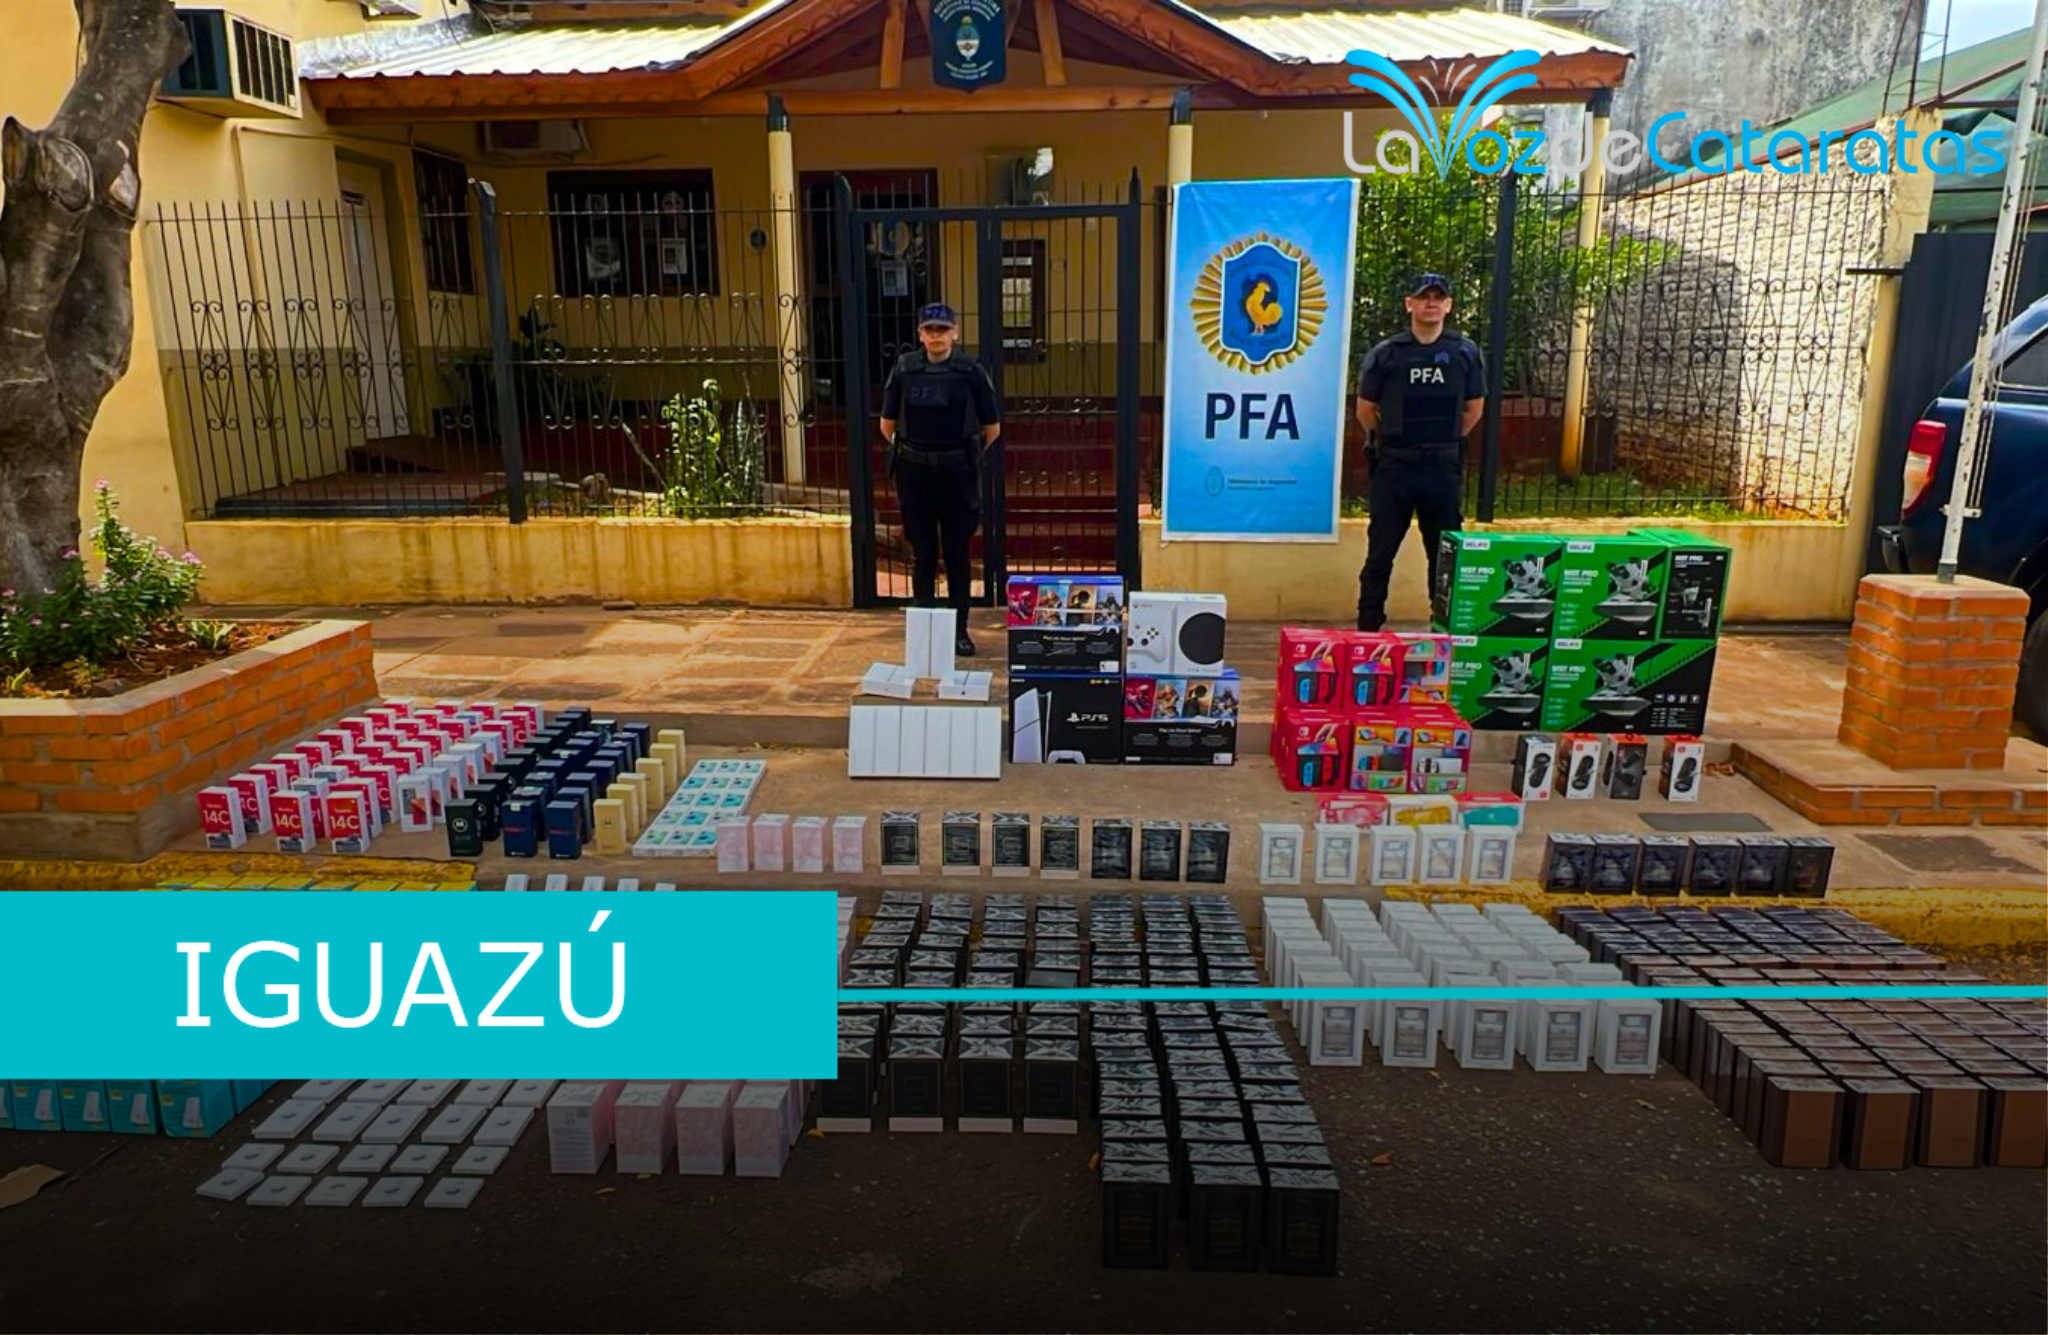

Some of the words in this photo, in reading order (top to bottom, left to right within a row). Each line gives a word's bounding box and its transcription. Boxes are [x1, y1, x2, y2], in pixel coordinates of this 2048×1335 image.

[1409, 367, 1445, 384] PFA
[1205, 392, 1300, 440] PFA
[1081, 713, 1109, 722] PS5
[203, 809, 231, 825] 14C
[273, 813, 301, 829] 14C
[329, 814, 359, 830] 14C
